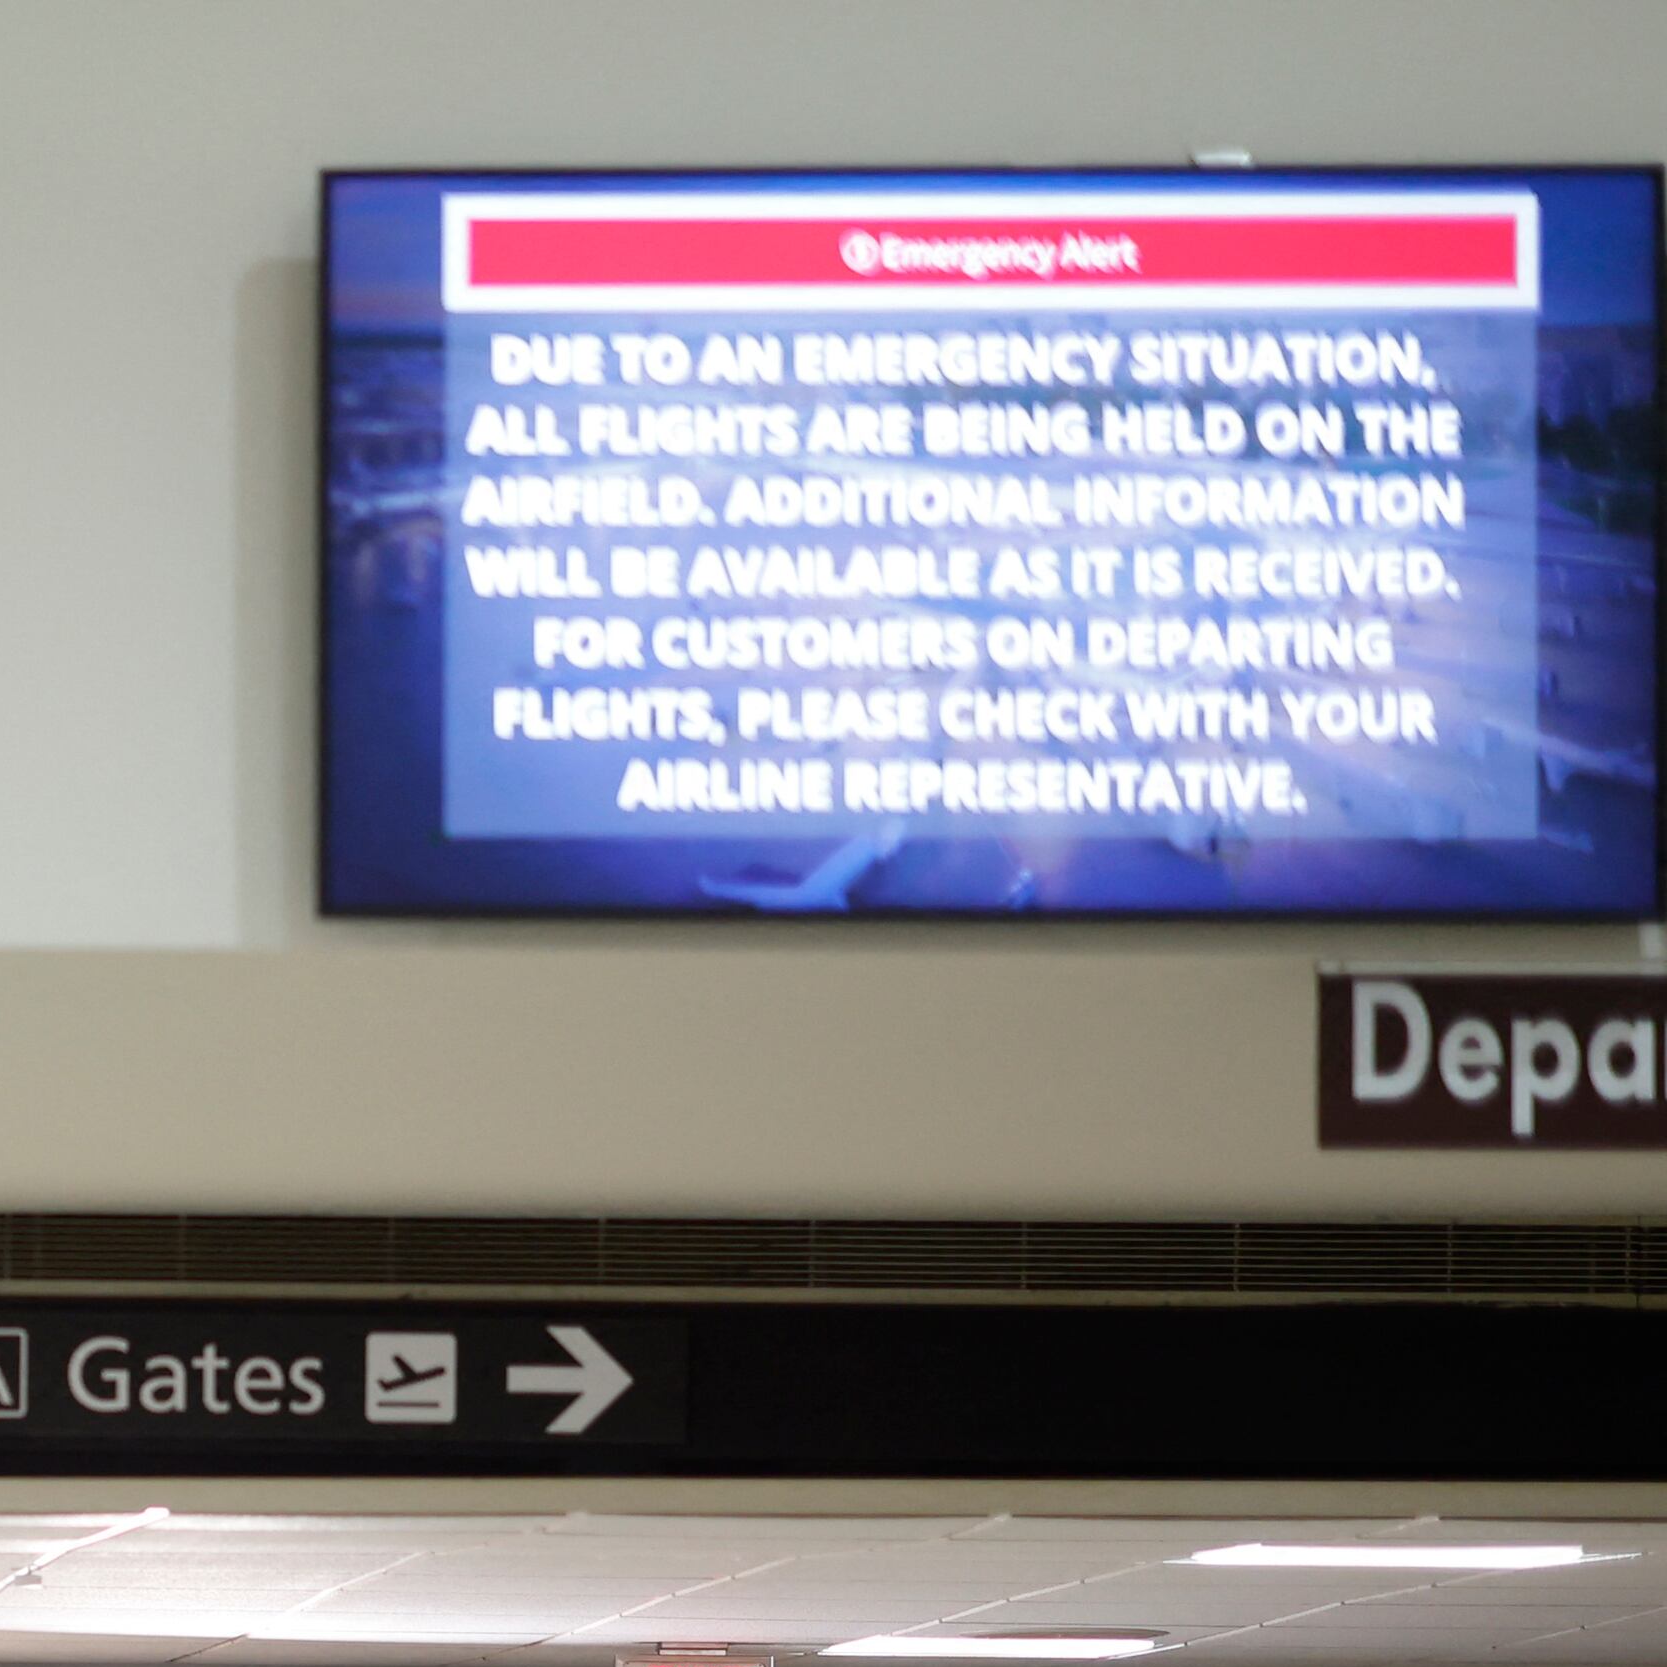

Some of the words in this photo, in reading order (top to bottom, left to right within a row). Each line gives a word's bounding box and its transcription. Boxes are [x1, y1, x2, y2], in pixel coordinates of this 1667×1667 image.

[879, 231, 1055, 280] Emergency
[1060, 230, 1142, 274] Alert
[491, 332, 606, 386] DUE
[610, 332, 692, 386] TO
[698, 332, 784, 386] AN
[793, 332, 1121, 386] EMERGENCY
[465, 404, 571, 457] ALL
[579, 404, 799, 457] FLIGHTS
[806, 404, 914, 457] ARE
[923, 404, 1091, 457] BEING
[1102, 404, 1247, 457] HELD
[1255, 404, 1345, 457] ON
[1354, 404, 1464, 457] THE
[462, 474, 716, 527] AIRFIELD.
[725, 474, 1062, 527] ADDITIONAL
[1073, 474, 1466, 527] INFORMATION
[464, 545, 602, 599] WILL
[611, 545, 682, 599] BE
[687, 545, 980, 599] AVAILABLE
[988, 545, 1062, 599] AS
[1070, 545, 1123, 599] IT
[1133, 545, 1183, 599] IS
[1192, 545, 1462, 599] RECEIVED.
[533, 616, 646, 671] FOR
[652, 616, 978, 671] CUSTOMERS
[985, 616, 1075, 671] ON
[1086, 616, 1395, 671] DEPARTING
[493, 686, 727, 747] FLIGHTS,
[737, 688, 930, 743] PLEASE
[938, 688, 1119, 743] CHECK
[1123, 688, 1271, 743] WITH
[1277, 688, 1439, 743] YOUR
[616, 758, 834, 814] AIRLINE
[843, 758, 1309, 814] REPRESENTATIVE.
[1350, 979, 1667, 1139] Depa
[68, 1335, 326, 1415] Gates
